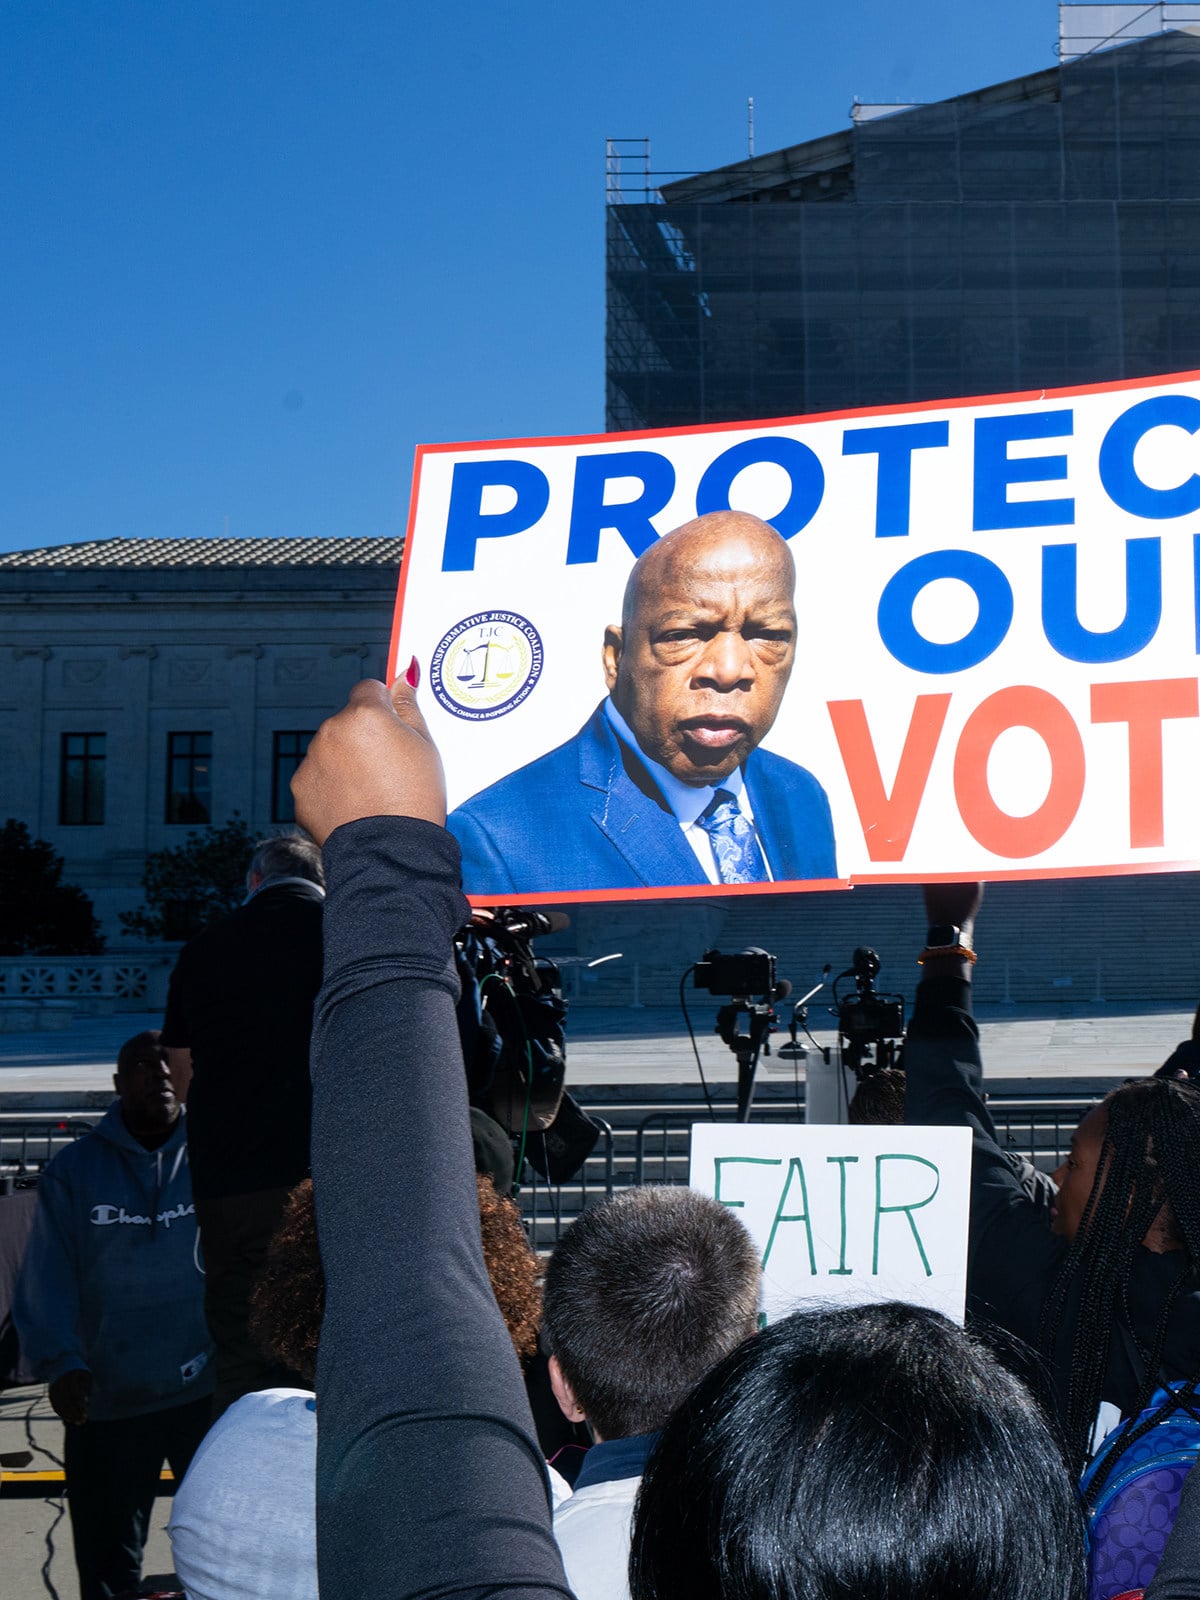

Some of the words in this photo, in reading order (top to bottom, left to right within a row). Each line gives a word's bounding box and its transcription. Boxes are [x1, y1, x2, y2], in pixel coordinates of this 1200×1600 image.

[431, 613, 489, 685] TRANSFORMATIVE
[489, 612, 527, 630] JUSTICE
[523, 626, 543, 678] COALITION
[478, 626, 503, 638] TJC
[457, 709, 481, 720] CHANGE
[485, 702, 515, 719] INSPIRING
[513, 685, 532, 706] ACTION
[714, 1154, 940, 1277] FAIR
